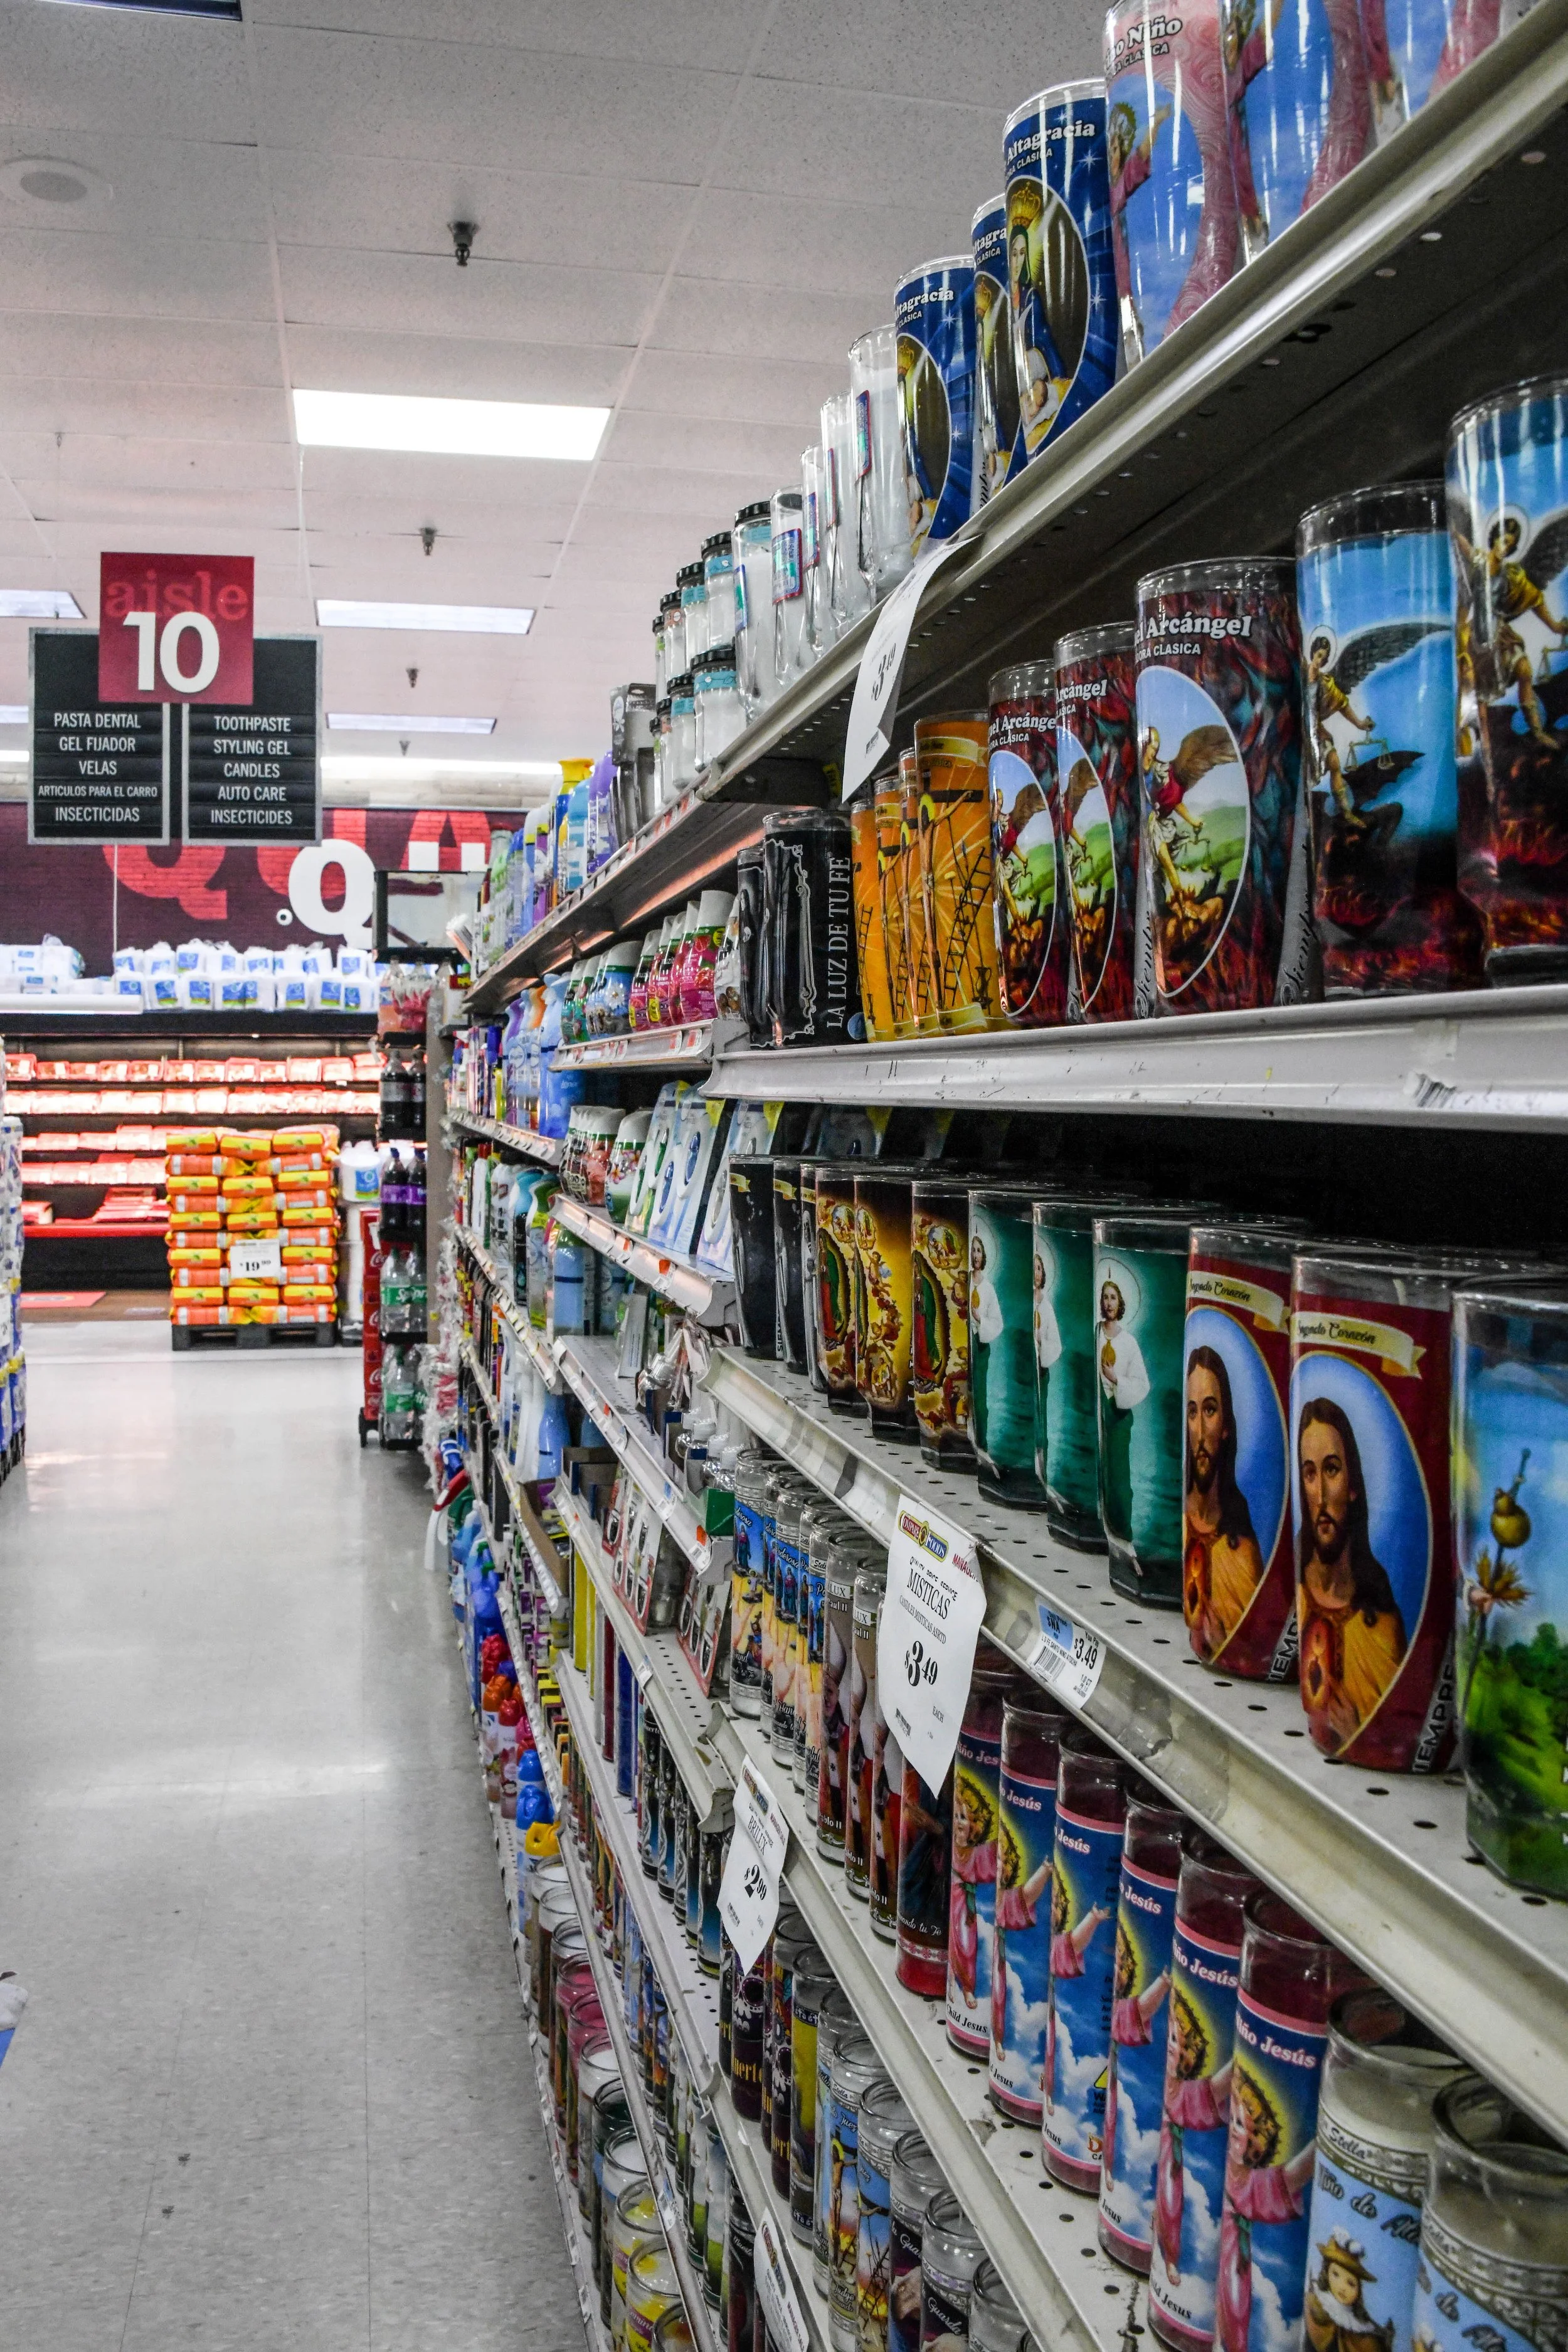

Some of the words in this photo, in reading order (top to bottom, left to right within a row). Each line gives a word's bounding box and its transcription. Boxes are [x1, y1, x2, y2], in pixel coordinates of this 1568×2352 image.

[1007, 120, 1095, 165] Altagracia
[105, 569, 249, 621] aisle
[1147, 612, 1253, 640] Arcángel
[123, 611, 220, 694] 10
[1153, 644, 1201, 655] CLASICA
[54, 712, 93, 728] PASTA
[95, 713, 141, 729] DENTAL
[214, 716, 292, 732] TOOTHPASTE
[60, 736, 84, 752] GEL
[87, 736, 136, 752] FIJADOR
[214, 739, 264, 755] STYLING
[267, 740, 291, 756] GEL
[79, 760, 117, 776] VELAS
[224, 763, 280, 778] CANDLES
[38, 785, 87, 797] ARTICULOS
[88, 785, 112, 797] PARA
[114, 785, 125, 797] EL
[127, 785, 158, 797] CARRO
[218, 786, 251, 802] AUTO
[253, 787, 287, 802] CARE
[55, 807, 140, 822] INSECTICIDAS
[211, 808, 293, 825] INSECTICIDES
[829, 857, 850, 884] FE
[829, 888, 849, 918] TU
[829, 923, 849, 951] DE
[828, 958, 847, 1000] LUZ
[827, 1005, 845, 1029] LA
[1329, 1322, 1377, 1345] Corazón
[925, 1531, 946, 1559] FOODS
[906, 1568, 951, 1619] MISTICAS
[899, 1594, 915, 1616] CANDLES
[914, 1610, 933, 1633] MISTICAS
[931, 1624, 946, 1645] ASRTD
[1074, 1638, 1098, 1670] $3.49
[932, 1705, 944, 1724] EACH
[1007, 1789, 1042, 1813] Jesús
[748, 1815, 768, 1856] BRILUX
[1056, 1831, 1091, 1855] Jesús
[1125, 1884, 1162, 1915] Jesús
[1189, 1958, 1239, 1989] Jesús
[961, 2013, 988, 2033] Jesus
[1261, 2035, 1316, 2069] Jesús
[993, 2068, 1014, 2089] Jesus
[1044, 2122, 1062, 2146] Jesus
[928, 2297, 963, 2336] Guarda
[1162, 2291, 1193, 2321] Jesus
